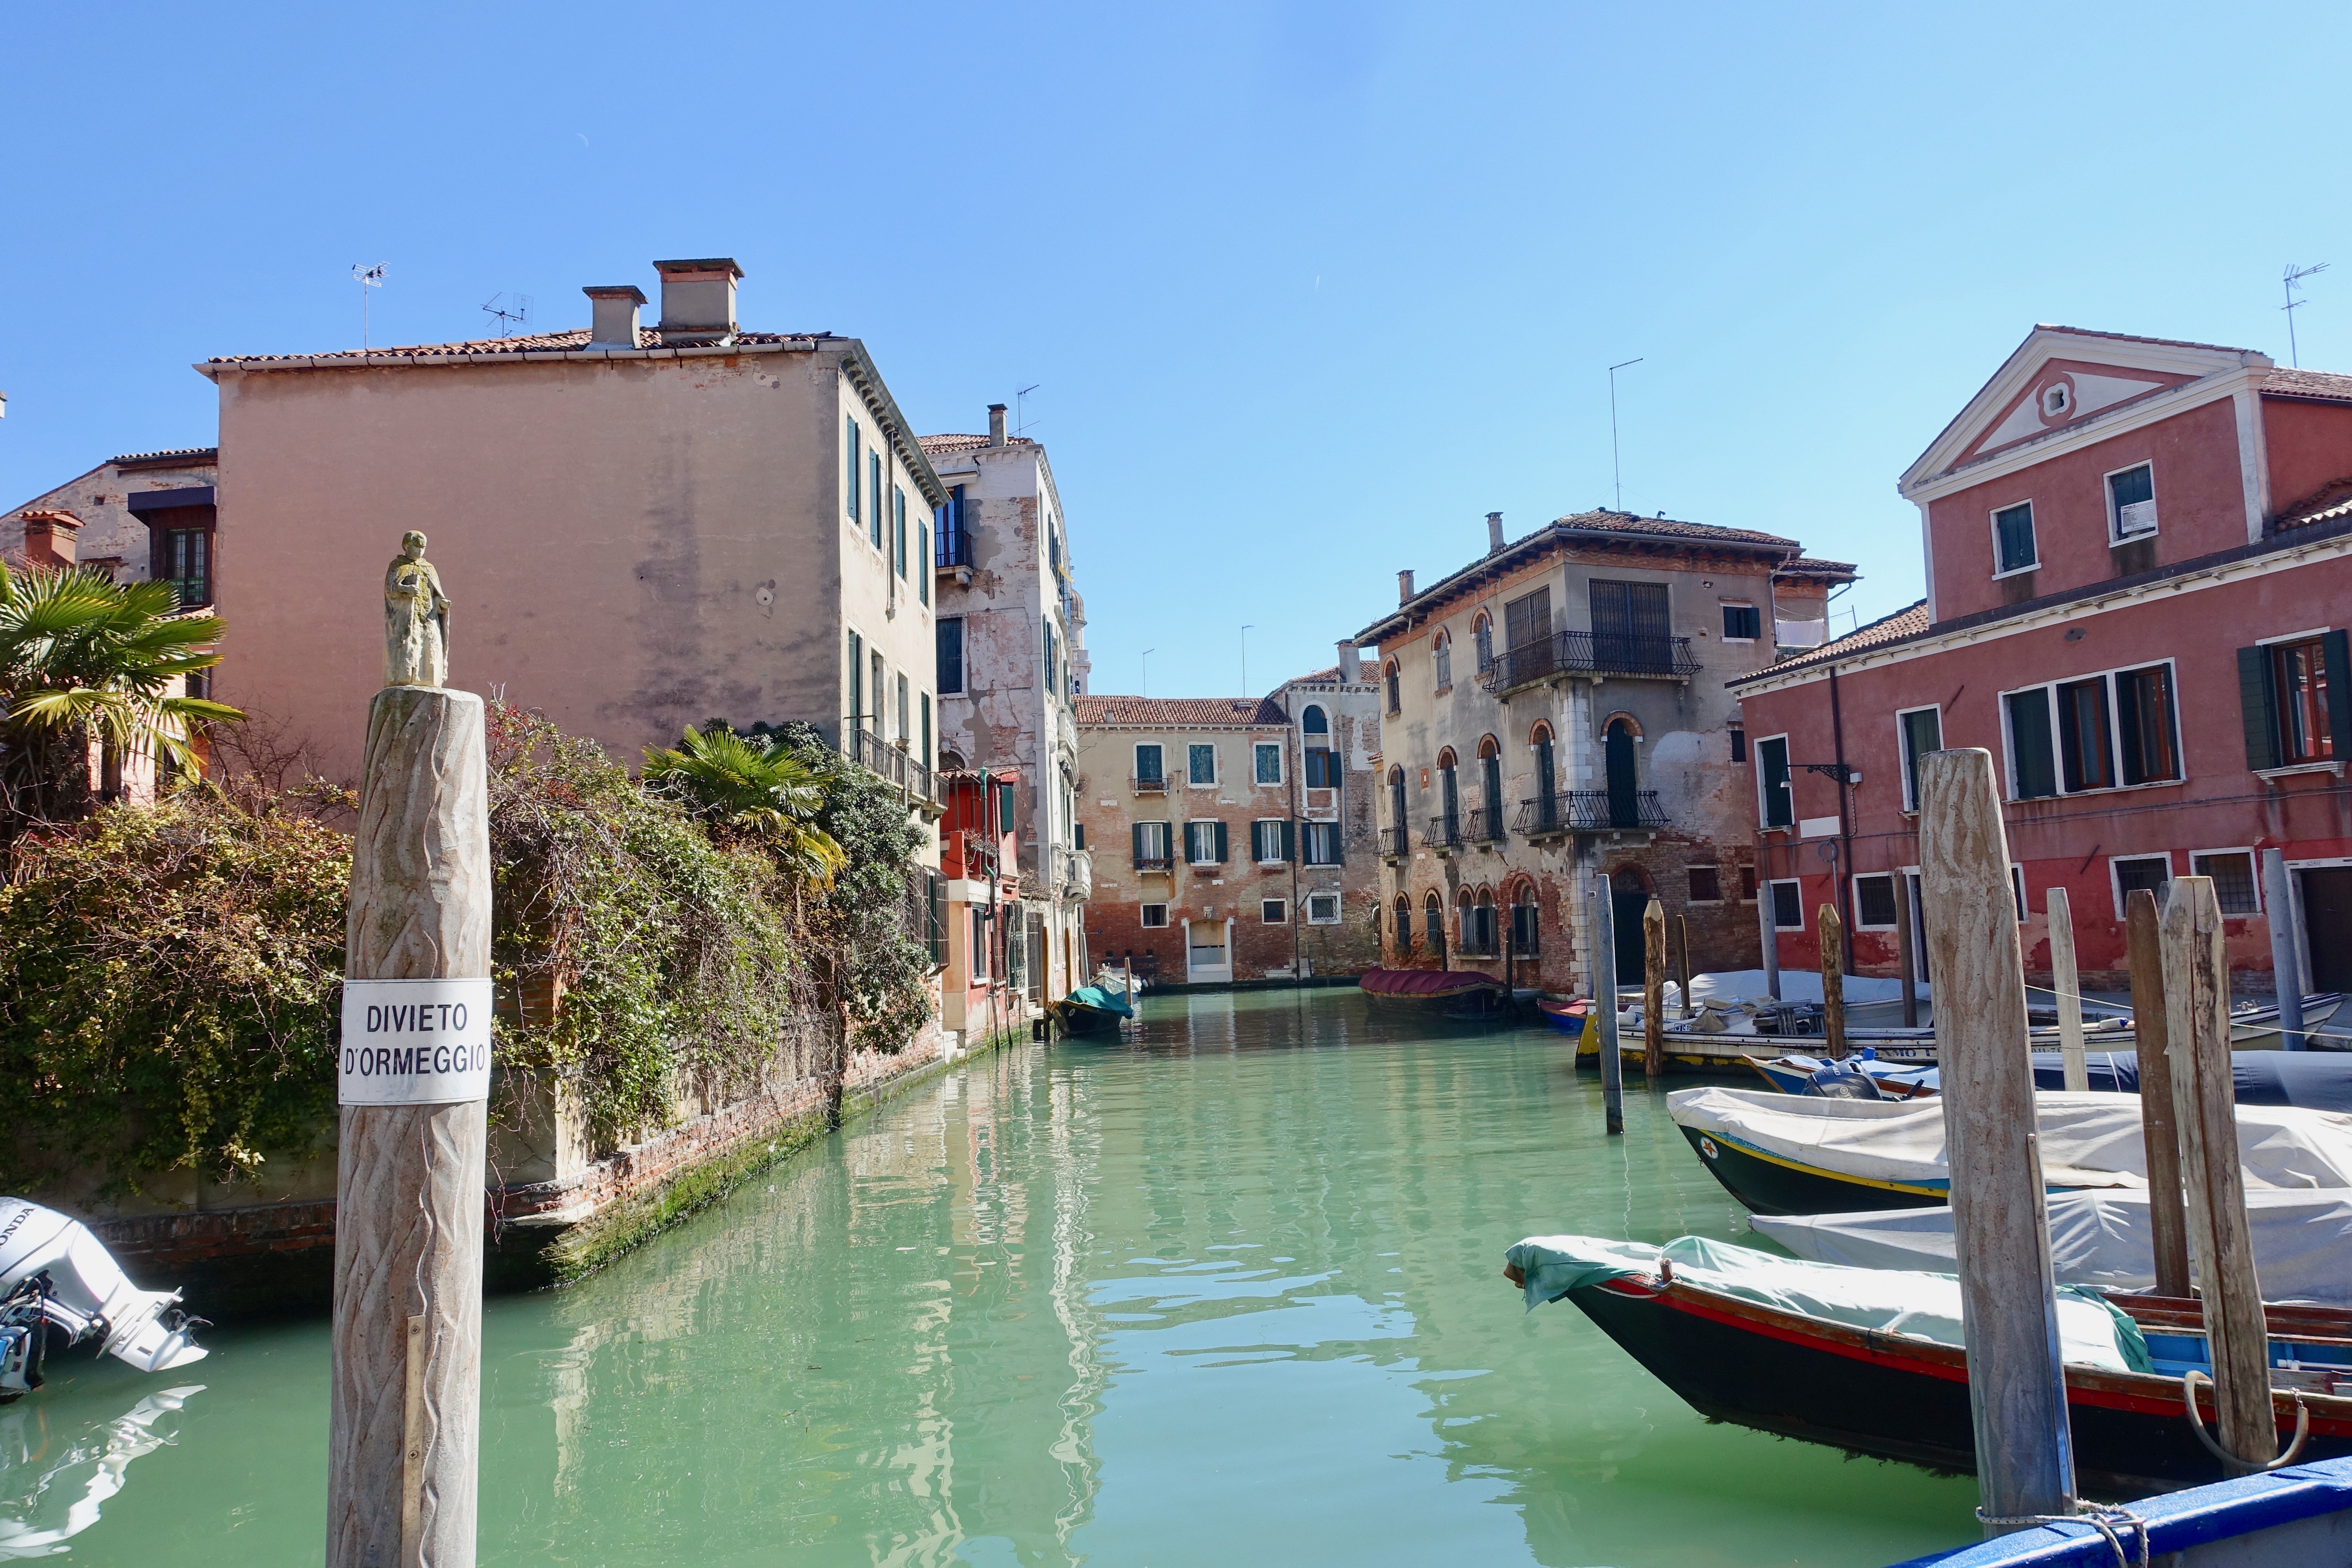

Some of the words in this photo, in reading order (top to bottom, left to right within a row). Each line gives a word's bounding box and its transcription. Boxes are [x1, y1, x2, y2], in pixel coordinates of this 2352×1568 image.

[367, 1003, 467, 1032] DIVIETO
[346, 1044, 484, 1076] D'ORMEGGIO
[0, 1208, 36, 1249] ONDA
